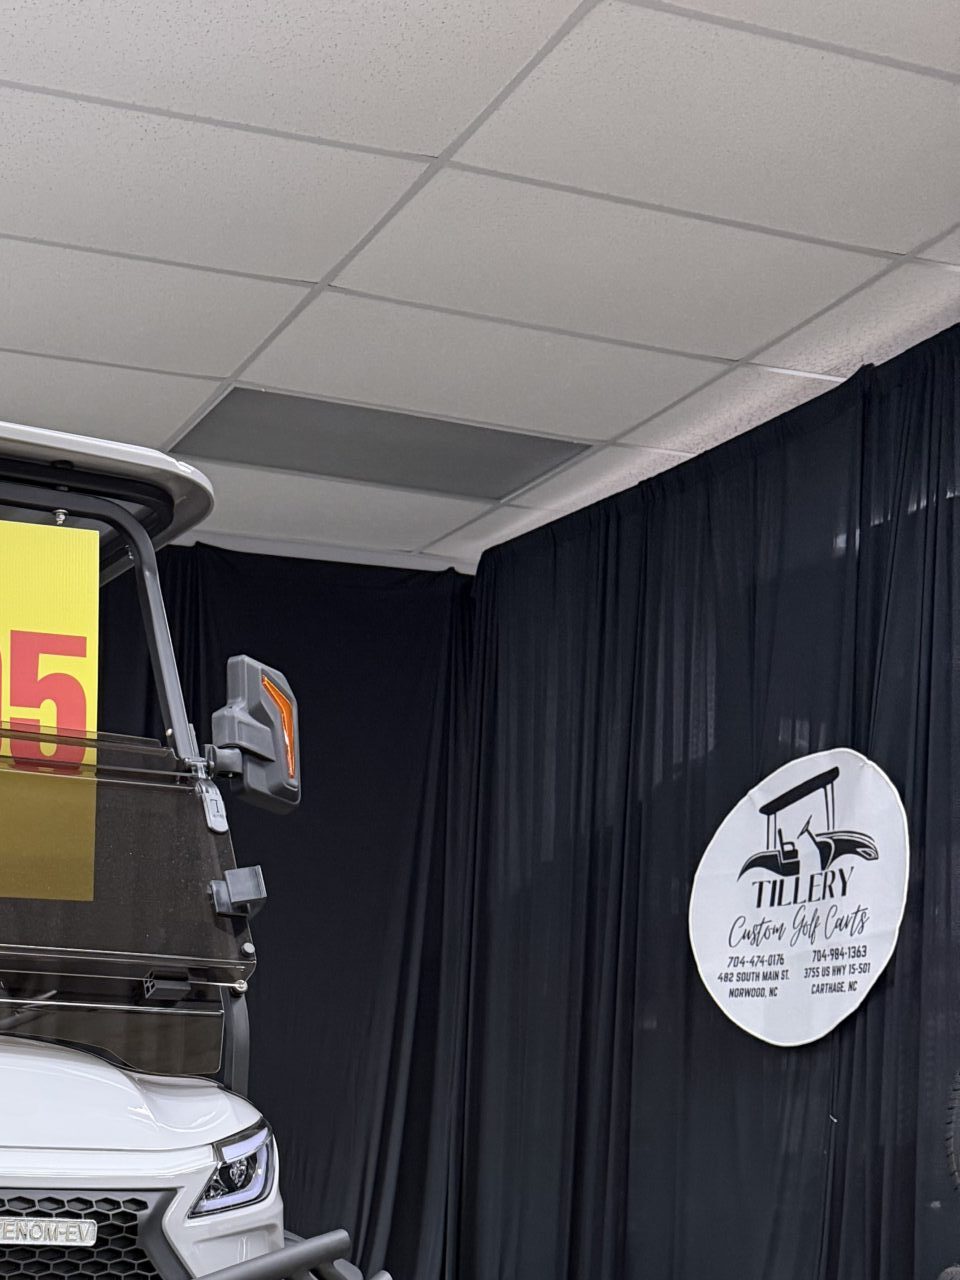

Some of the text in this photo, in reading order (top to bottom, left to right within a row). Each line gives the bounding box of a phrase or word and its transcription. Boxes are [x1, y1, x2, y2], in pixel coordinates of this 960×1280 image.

[752, 866, 854, 908] TILLERY
[728, 904, 870, 948] Custom Golf Carts
[727, 953, 785, 968] 704-474-0176
[812, 945, 868, 962] 704-984-1363
[717, 969, 790, 982] 482 SOUTH MAIN ST.
[803, 962, 871, 978] 3755 US HWY 15-501
[729, 986, 779, 999] NORWOOD, NC
[847, 980, 858, 992] NC
